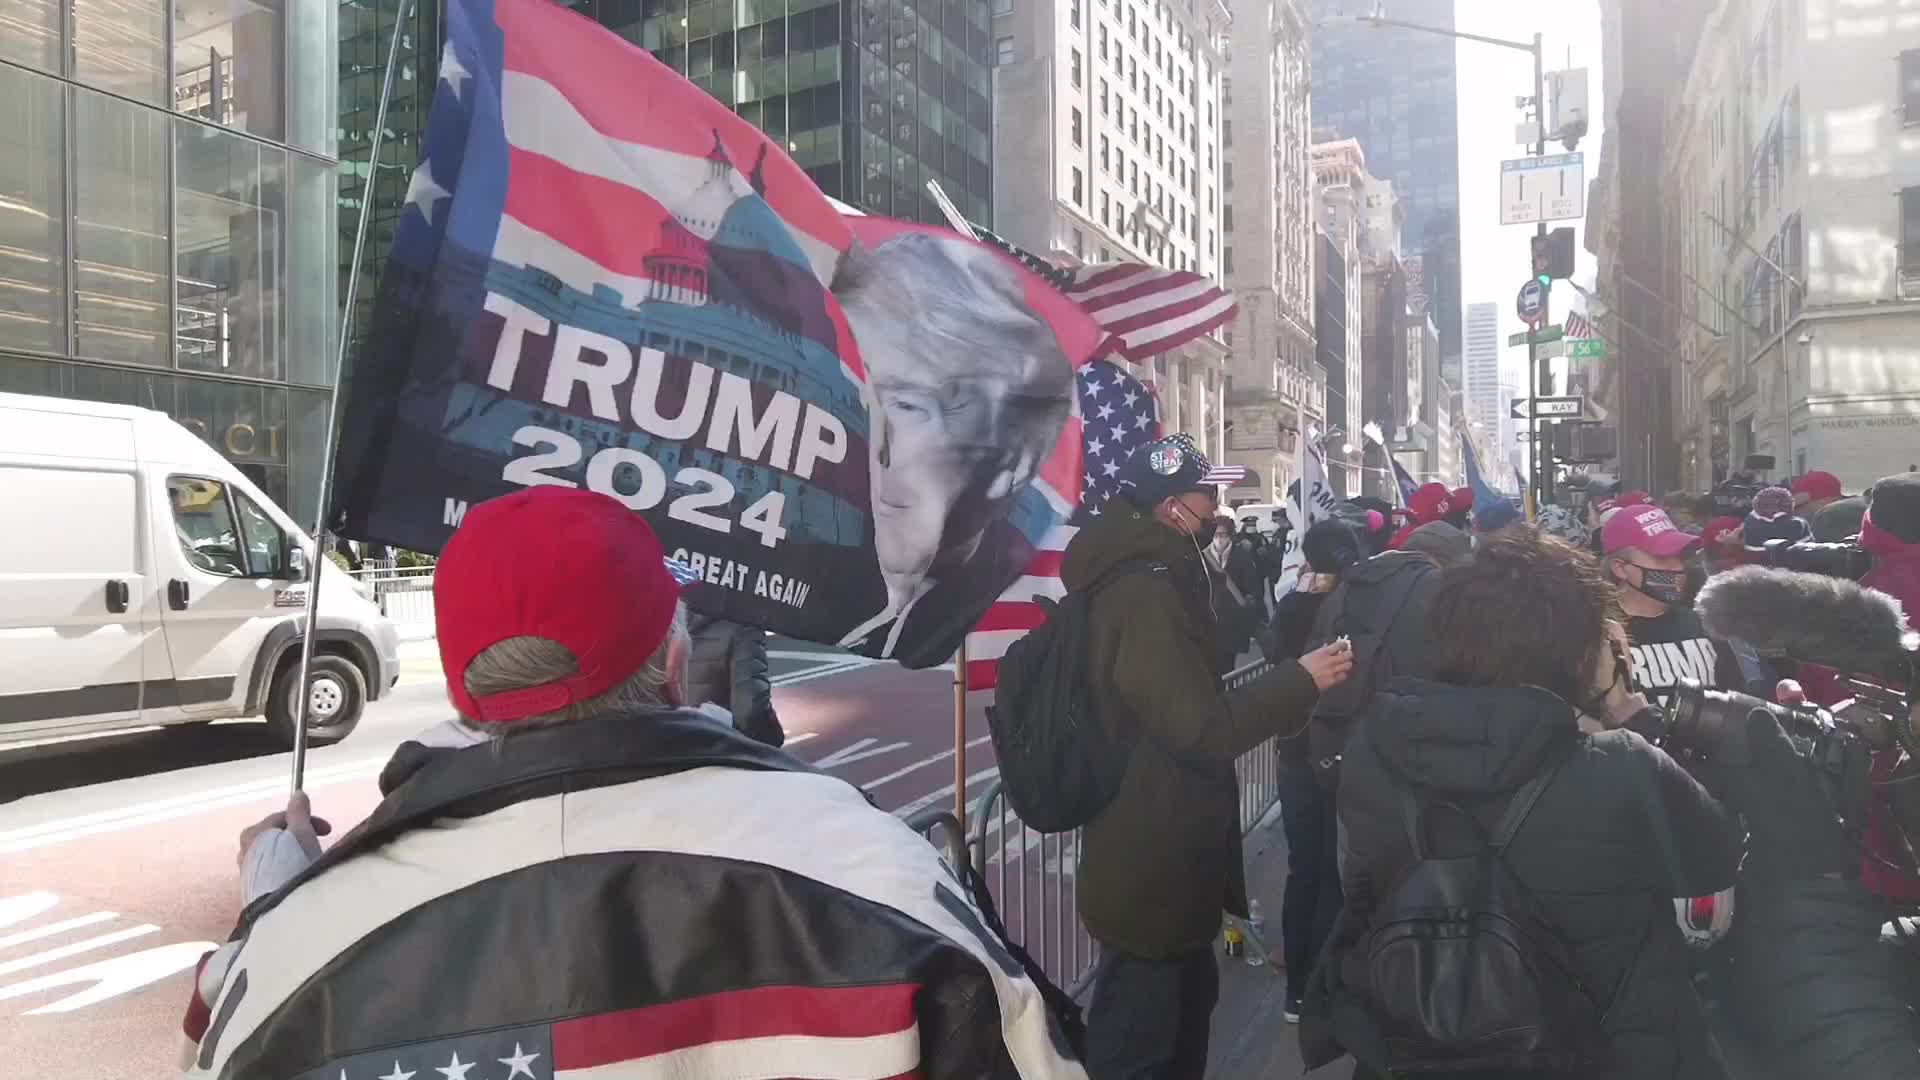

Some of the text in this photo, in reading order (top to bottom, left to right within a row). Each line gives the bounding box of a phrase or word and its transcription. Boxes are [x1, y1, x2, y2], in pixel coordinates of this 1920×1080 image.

[1578, 342, 1591, 356] 56
[483, 291, 847, 480] TRUMP
[1551, 402, 1574, 412] WAY
[502, 425, 787, 549] 2024
[754, 570, 811, 609] AGAIN
[1631, 637, 1718, 689] RUMP
